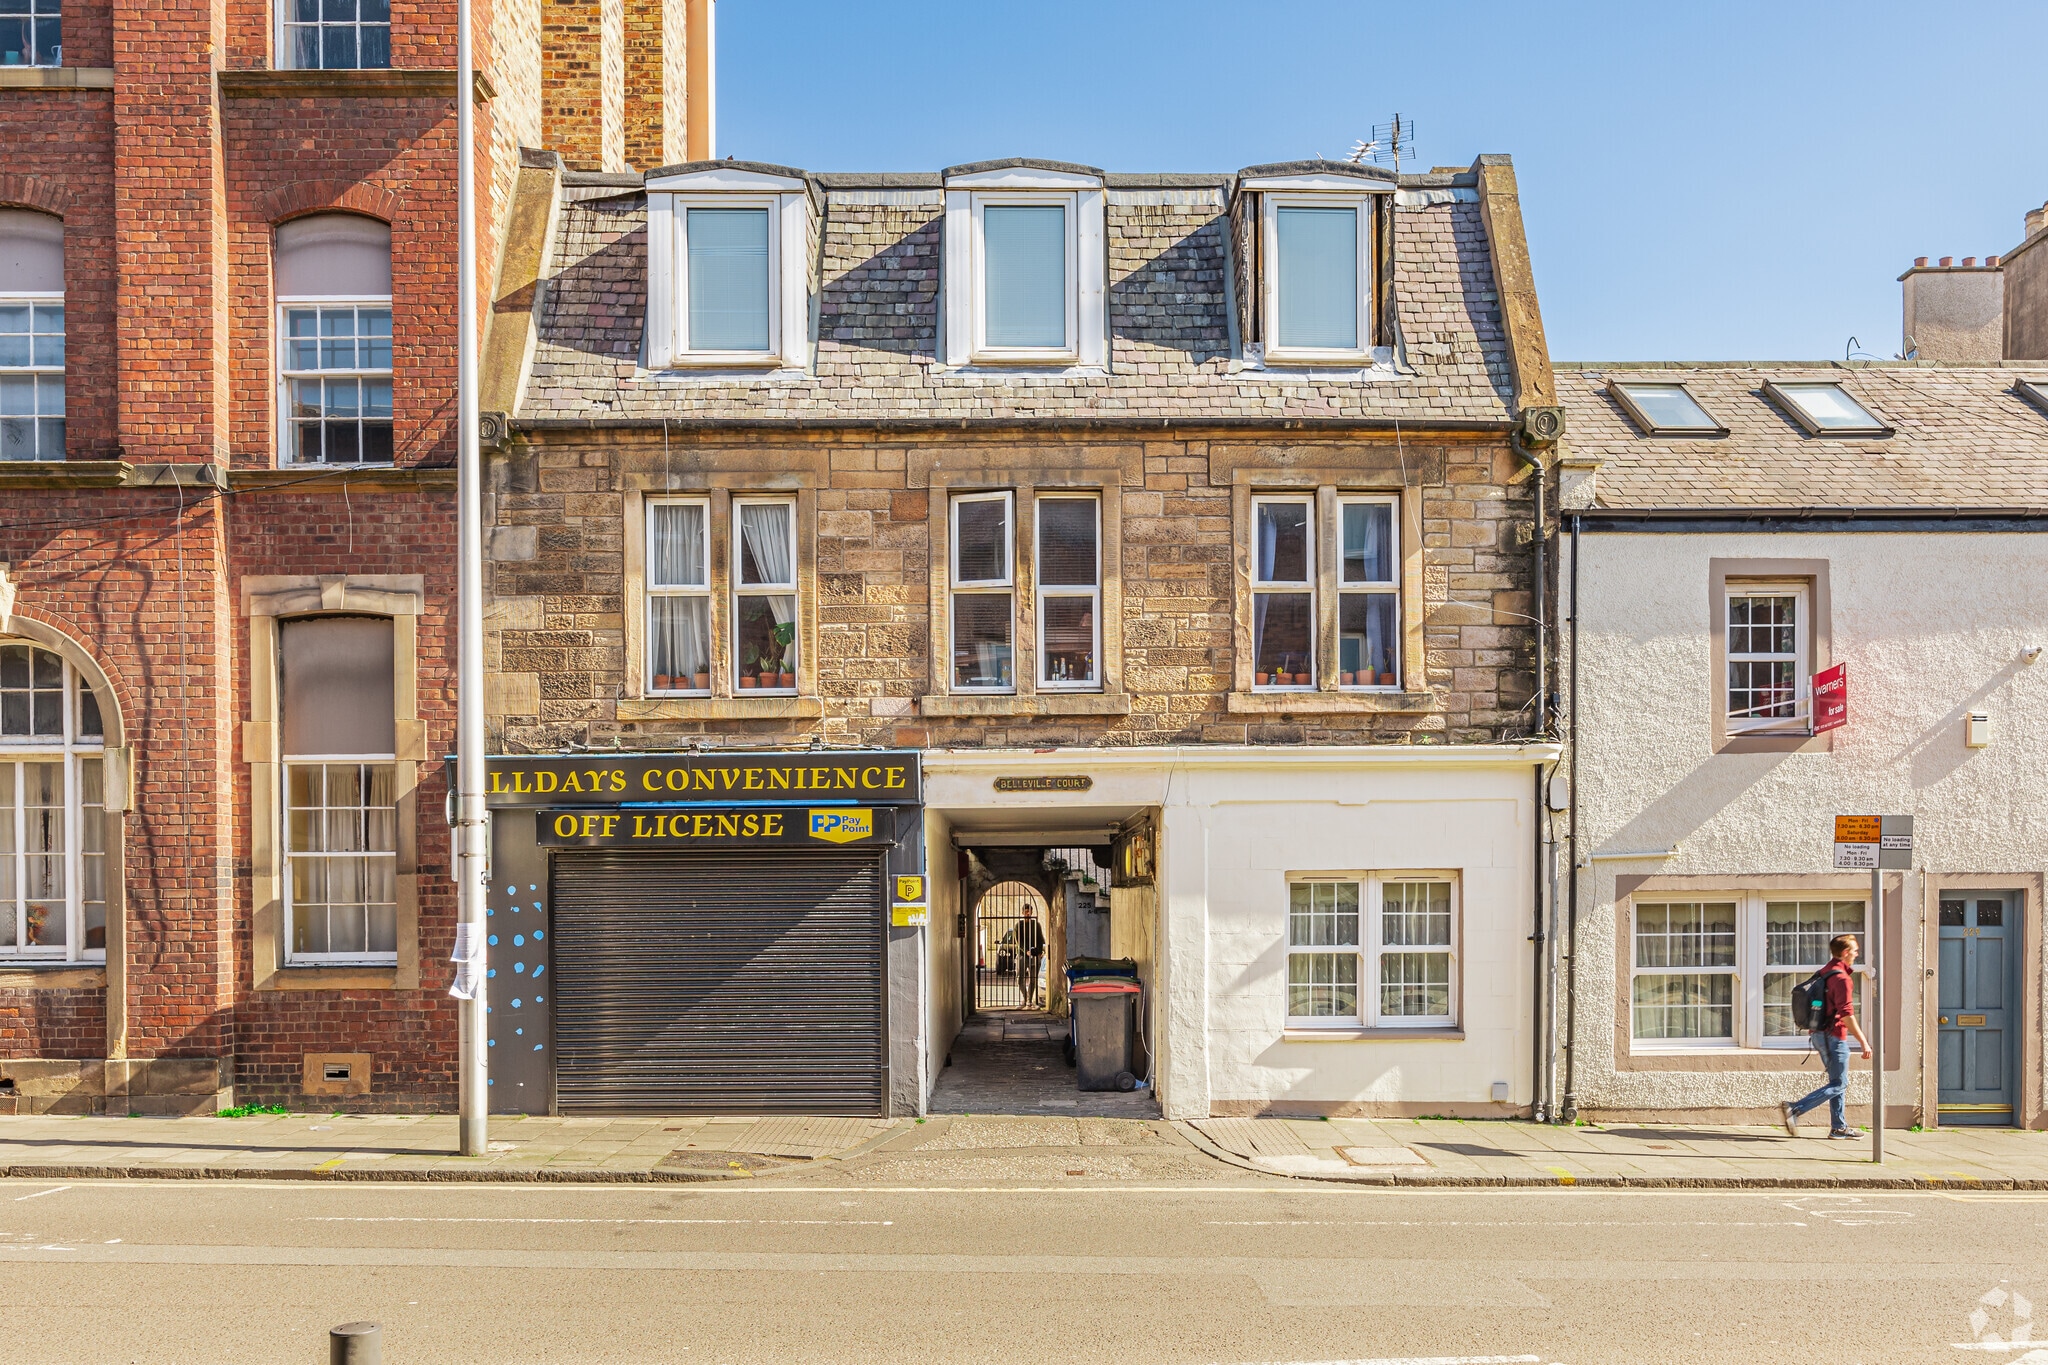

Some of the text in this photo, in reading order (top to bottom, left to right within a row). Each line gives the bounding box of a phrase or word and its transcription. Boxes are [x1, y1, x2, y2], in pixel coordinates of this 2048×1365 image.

[1815, 677, 1844, 696] warners
[1835, 703, 1844, 714] sale
[485, 766, 906, 794] LLDAYS CONVENIENCE
[1000, 779, 1086, 788] BELLEVILLE COURT
[554, 814, 784, 838] OFF LICENSE
[842, 816, 861, 826] Pay
[842, 825, 870, 833] Point
